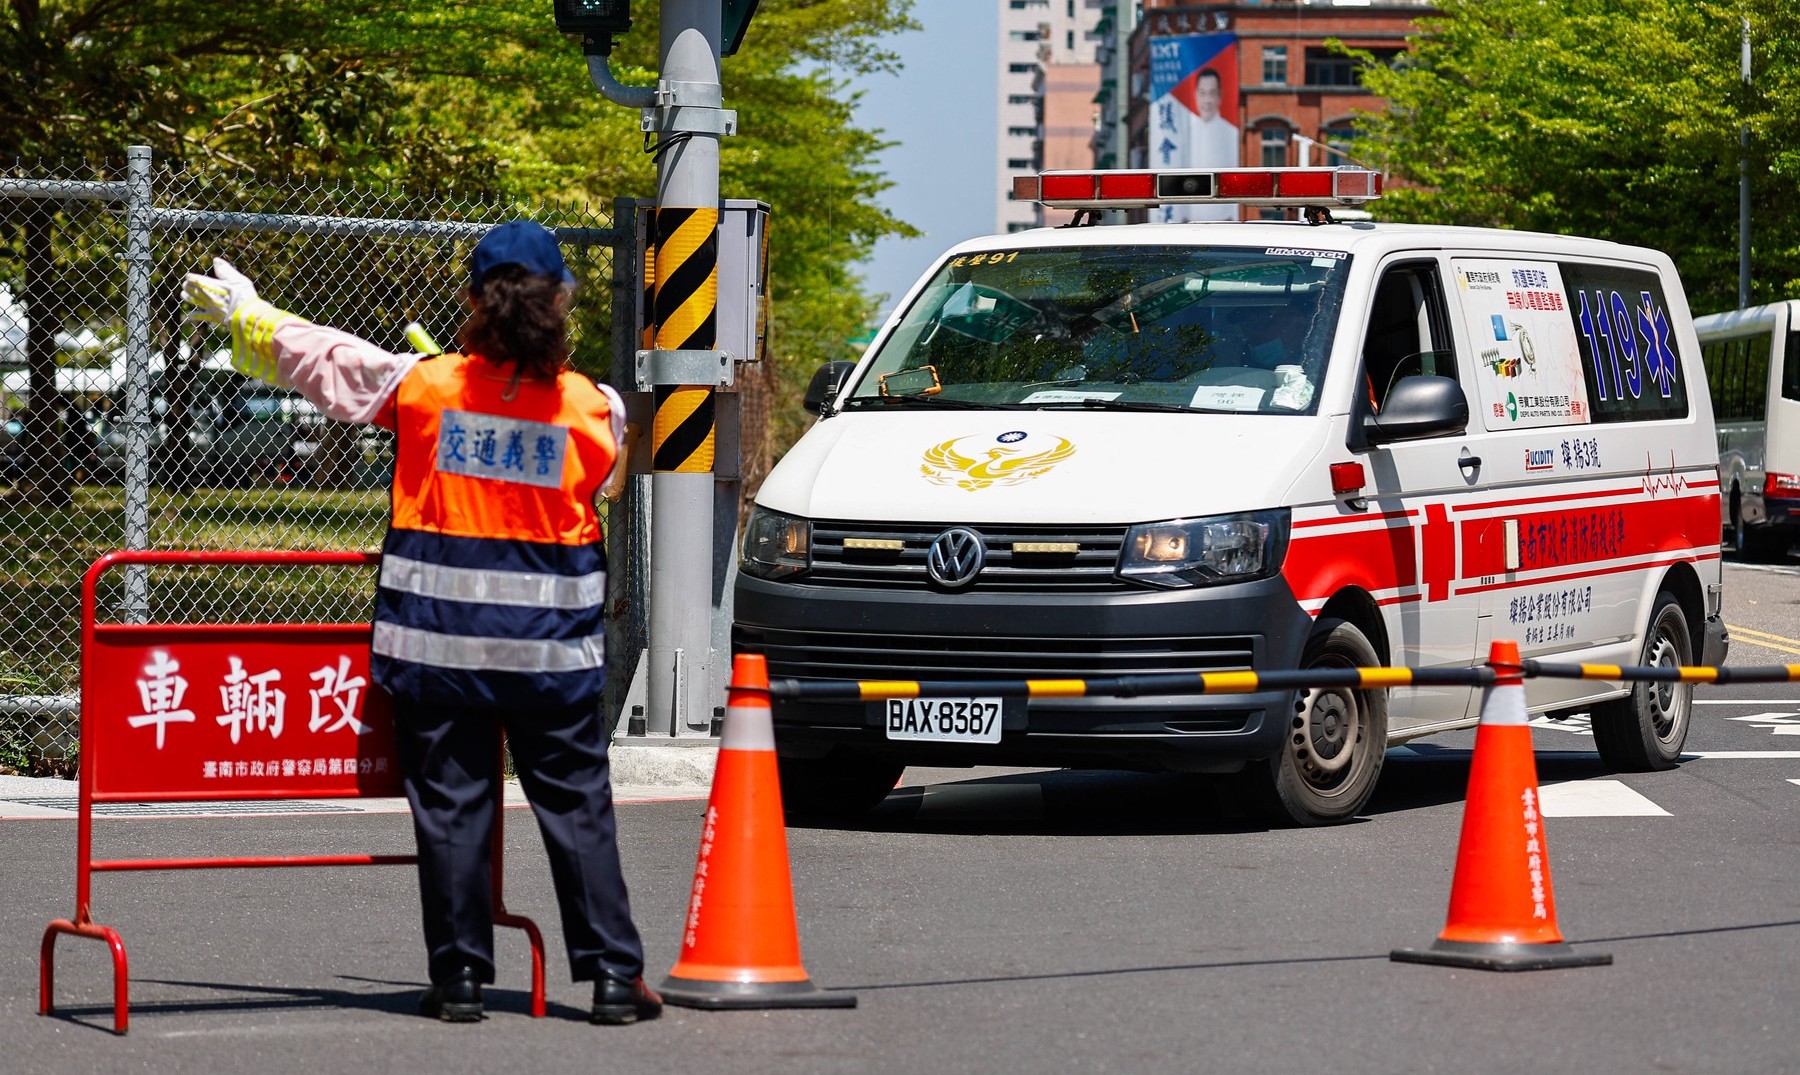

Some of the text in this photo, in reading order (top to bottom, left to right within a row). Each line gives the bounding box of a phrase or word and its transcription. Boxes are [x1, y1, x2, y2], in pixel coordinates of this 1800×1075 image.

[1267, 248, 1346, 259] LifeWATCH
[1580, 291, 1641, 400] 119
[445, 424, 556, 475] 交通義警
[127, 650, 374, 751] 車輛改
[202, 757, 388, 779] 臺南市政府警察局第四分局
